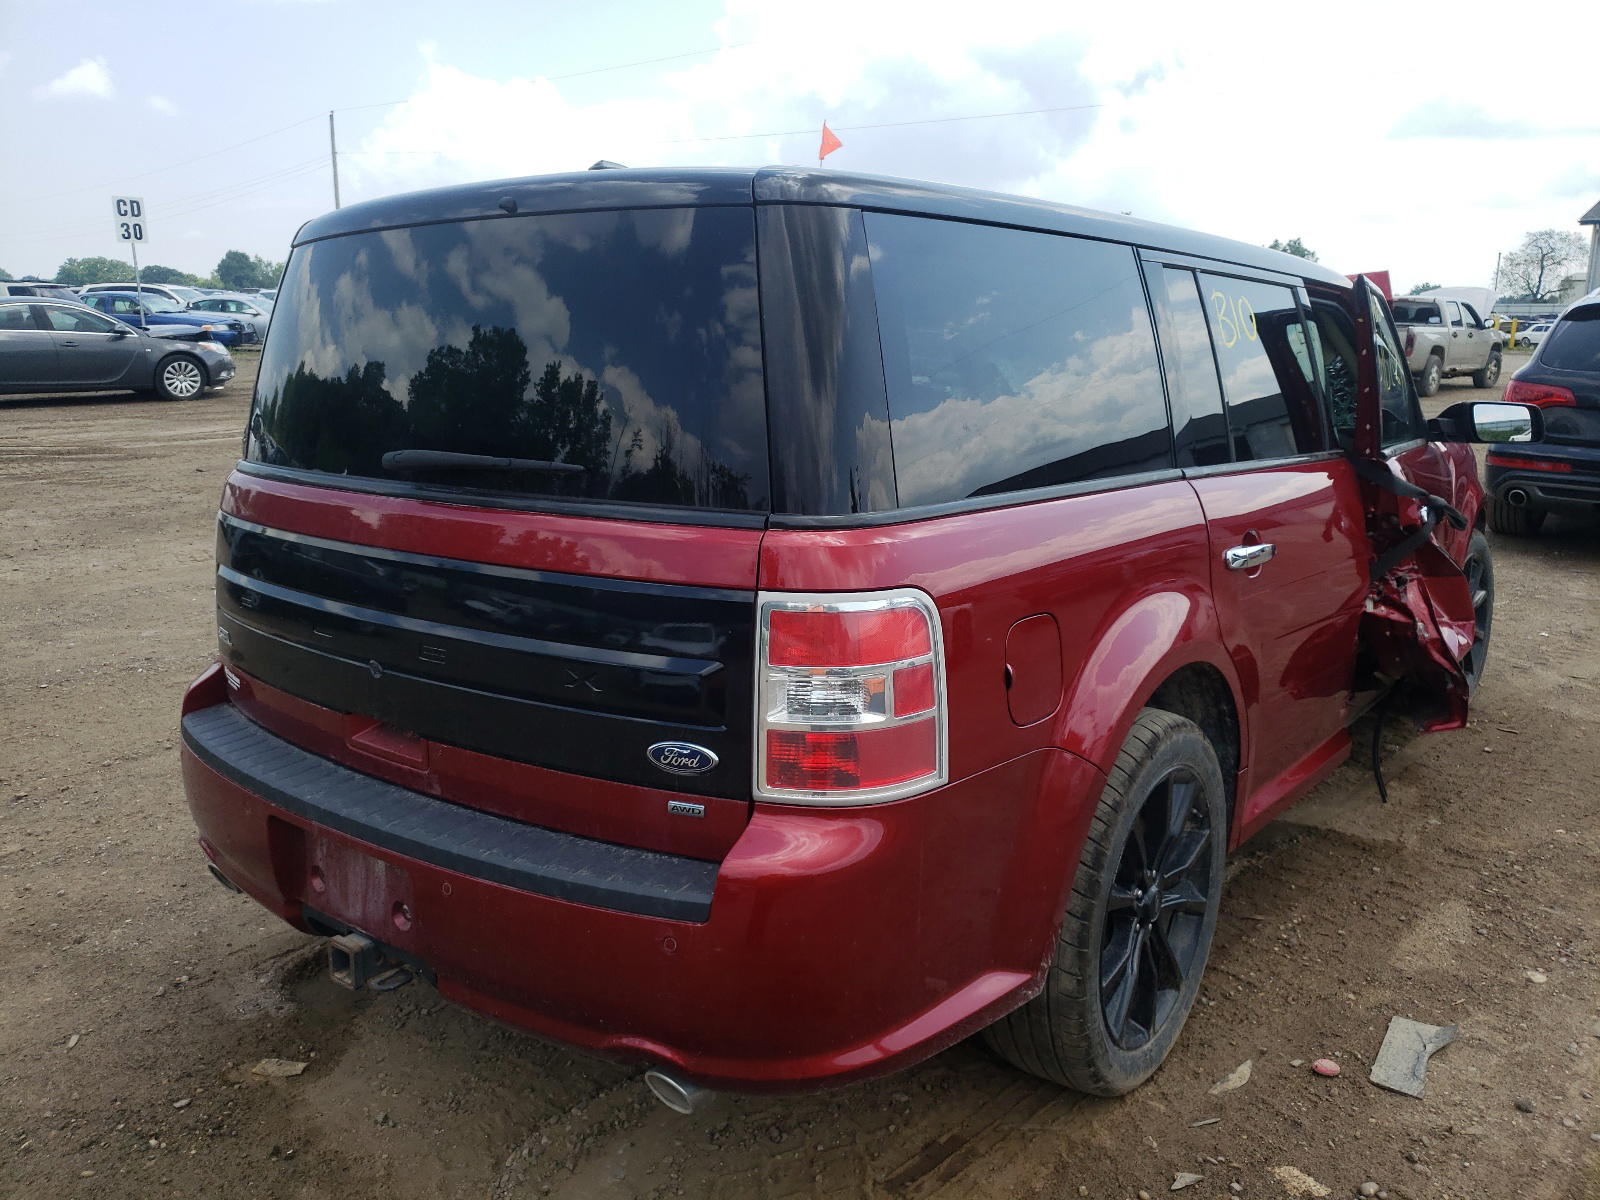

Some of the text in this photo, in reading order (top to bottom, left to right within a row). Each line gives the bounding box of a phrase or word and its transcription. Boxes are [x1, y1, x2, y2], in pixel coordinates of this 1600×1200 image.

[116, 198, 142, 218] CD
[120, 222, 143, 241] 30
[660, 746, 701, 768] Ford
[670, 804, 702, 816] AWD
